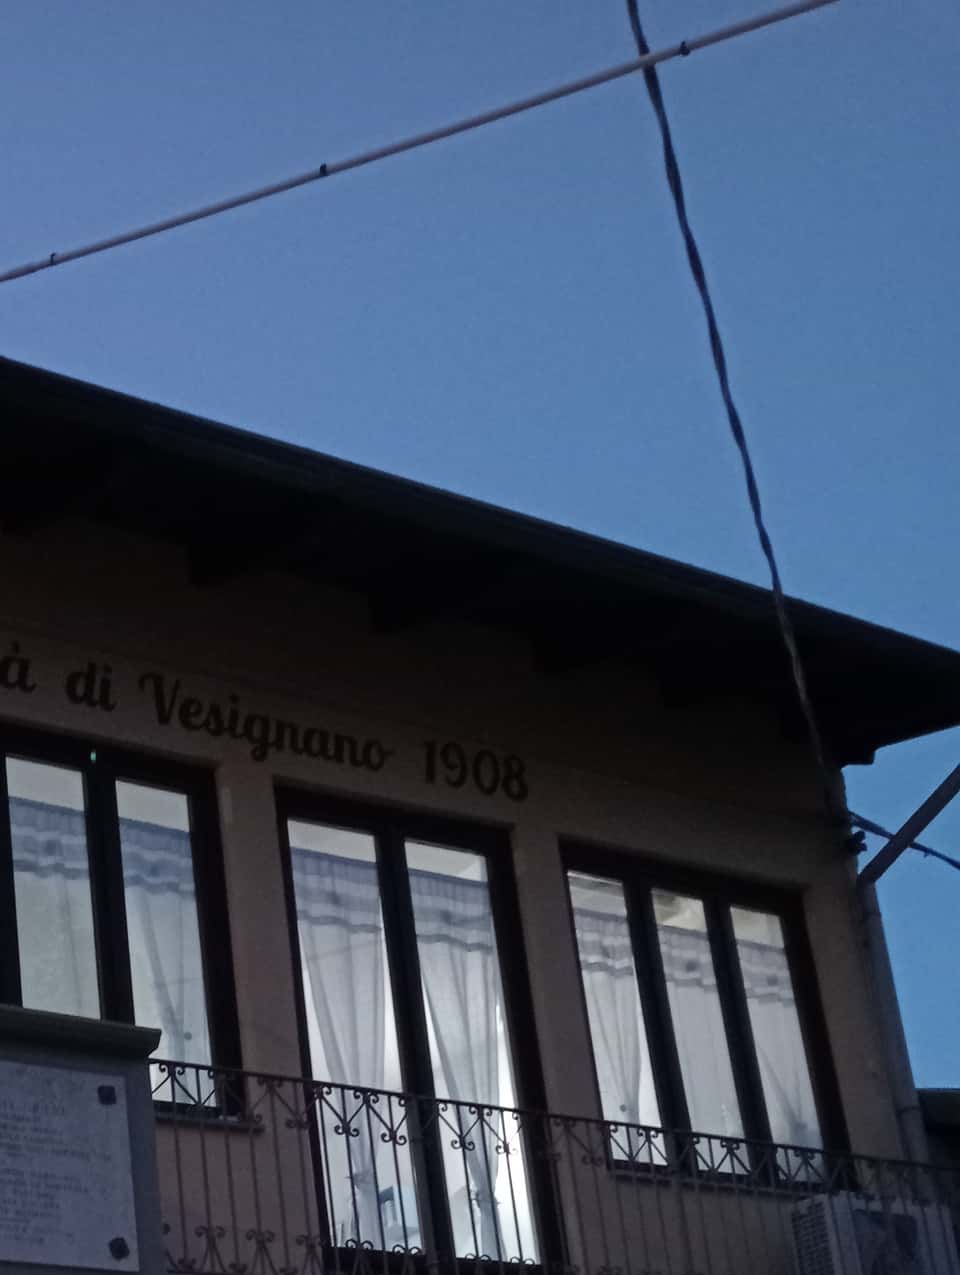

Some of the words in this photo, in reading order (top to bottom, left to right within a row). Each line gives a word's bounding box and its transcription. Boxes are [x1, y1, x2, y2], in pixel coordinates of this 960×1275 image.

[65, 661, 117, 712] di
[139, 671, 395, 770] Vesignano
[424, 738, 529, 802] 1908
